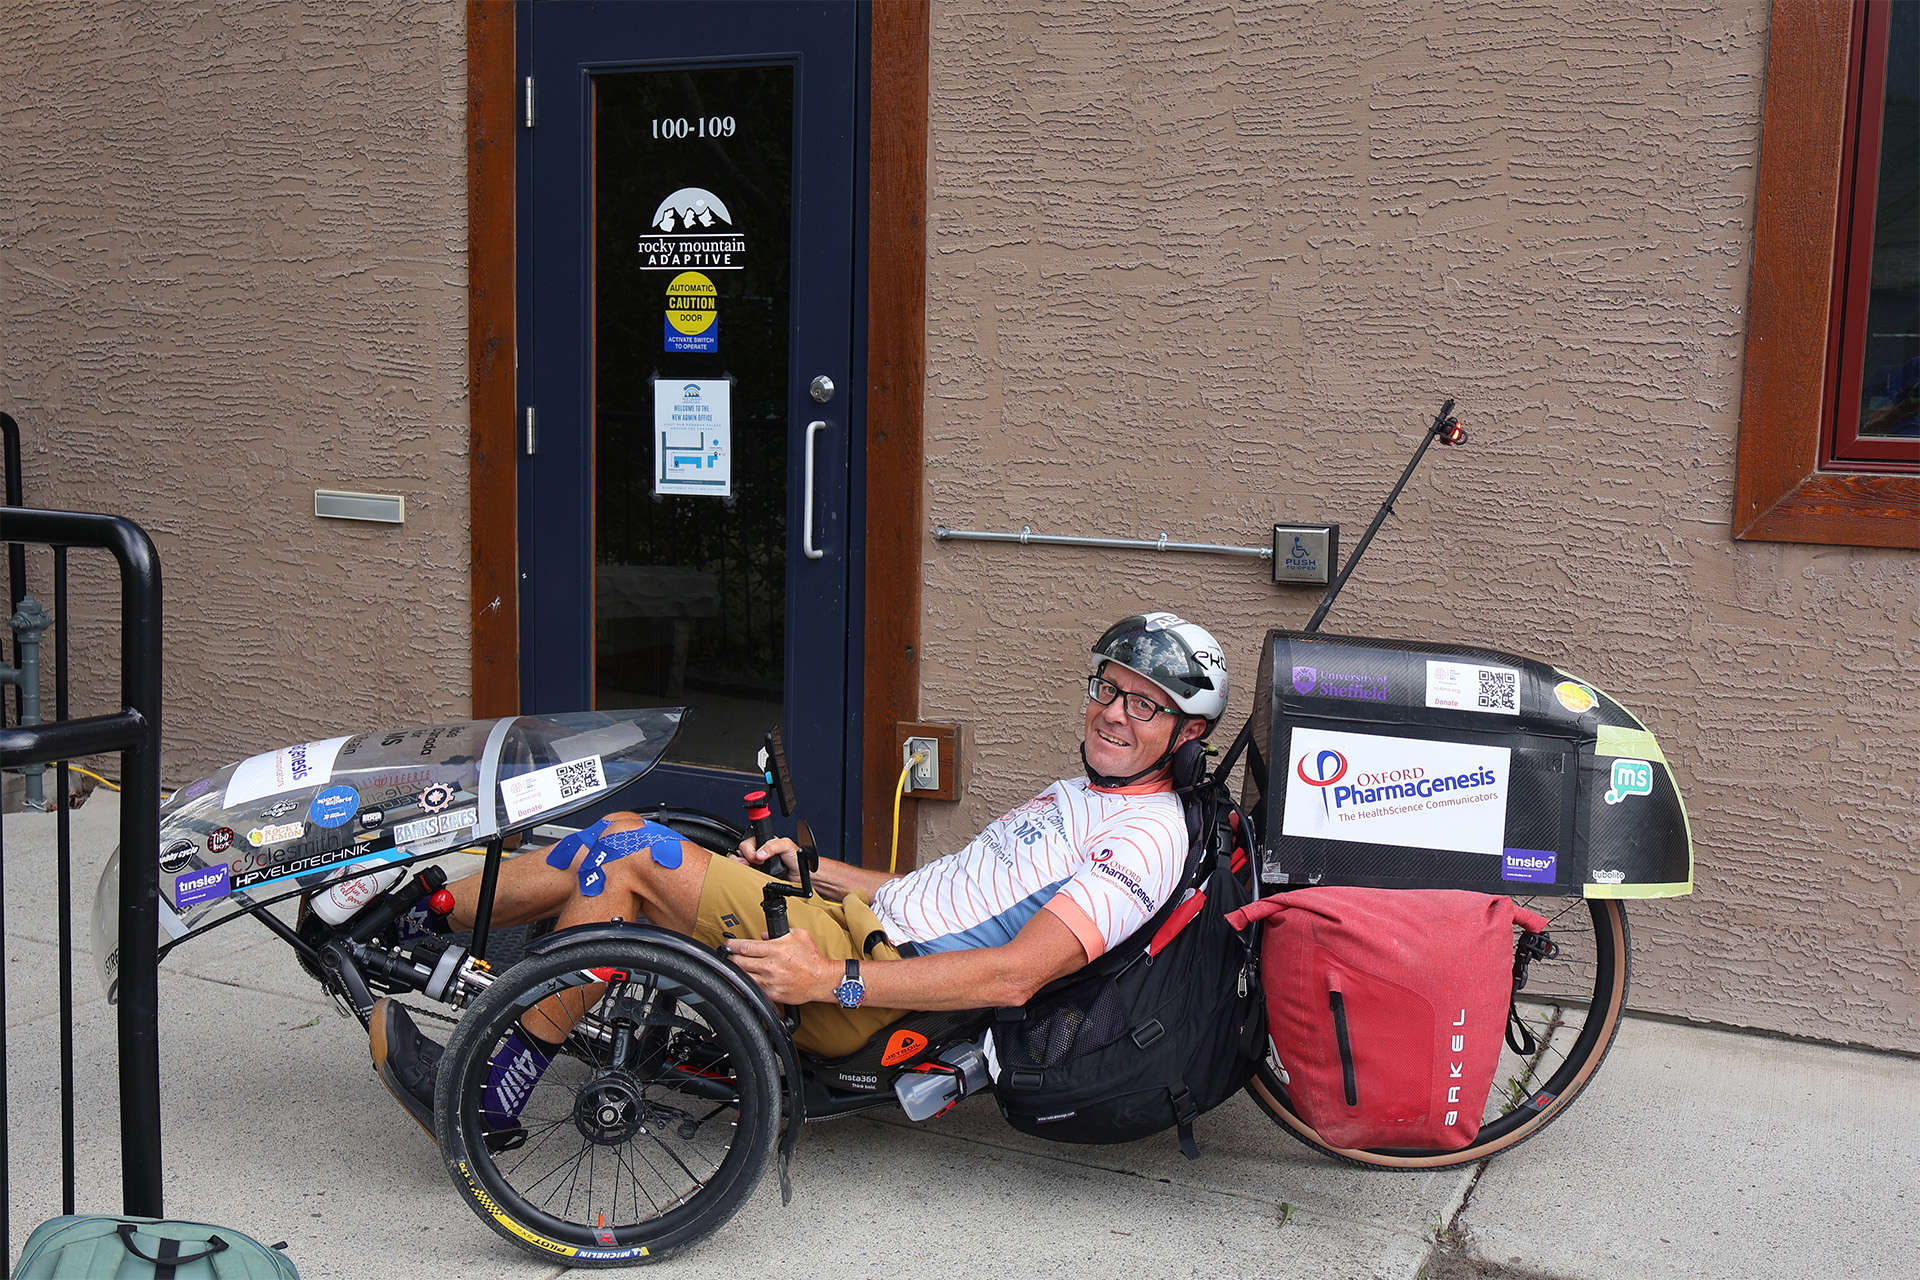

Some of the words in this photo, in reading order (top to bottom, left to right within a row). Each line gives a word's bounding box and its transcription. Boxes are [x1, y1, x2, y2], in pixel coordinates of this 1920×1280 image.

[652, 116, 736, 139] 100-109
[638, 239, 675, 256] rocky
[679, 238, 746, 252] mountain
[648, 254, 731, 265] ADAPTIVE
[670, 284, 714, 292] AUTOMATIC
[669, 297, 715, 310] CAUTION
[680, 314, 702, 322] DOOR
[1320, 670, 1375, 684] University
[1377, 674, 1388, 684] of
[1319, 683, 1387, 700] Sheffield
[1435, 697, 1459, 706] Donate
[1357, 767, 1425, 787] OXFORD
[1617, 768, 1648, 787] ms
[1334, 766, 1496, 809] PharmaGenesis
[518, 803, 543, 817] Donate
[1338, 813, 1356, 823] The
[1358, 802, 1424, 820] HealthScience
[1425, 792, 1499, 810] Communicators
[265, 823, 300, 835] ROCKY
[396, 818, 438, 843] BANKS
[440, 810, 476, 833] BIKES
[1013, 820, 1042, 845] MS
[212, 832, 229, 844] Tibo
[265, 829, 302, 843] LEMON
[1506, 855, 1551, 869] tinsley
[1109, 861, 1142, 883] OXFORD
[1593, 870, 1625, 879] tubolito
[179, 872, 224, 892] tinsley
[886, 1043, 921, 1061] JETBOIL
[1444, 1008, 1466, 1126] ARKEL
[839, 1072, 878, 1084] Insta360
[532, 1237, 568, 1253] PILOT
[579, 1250, 631, 1260] MICHELIN
